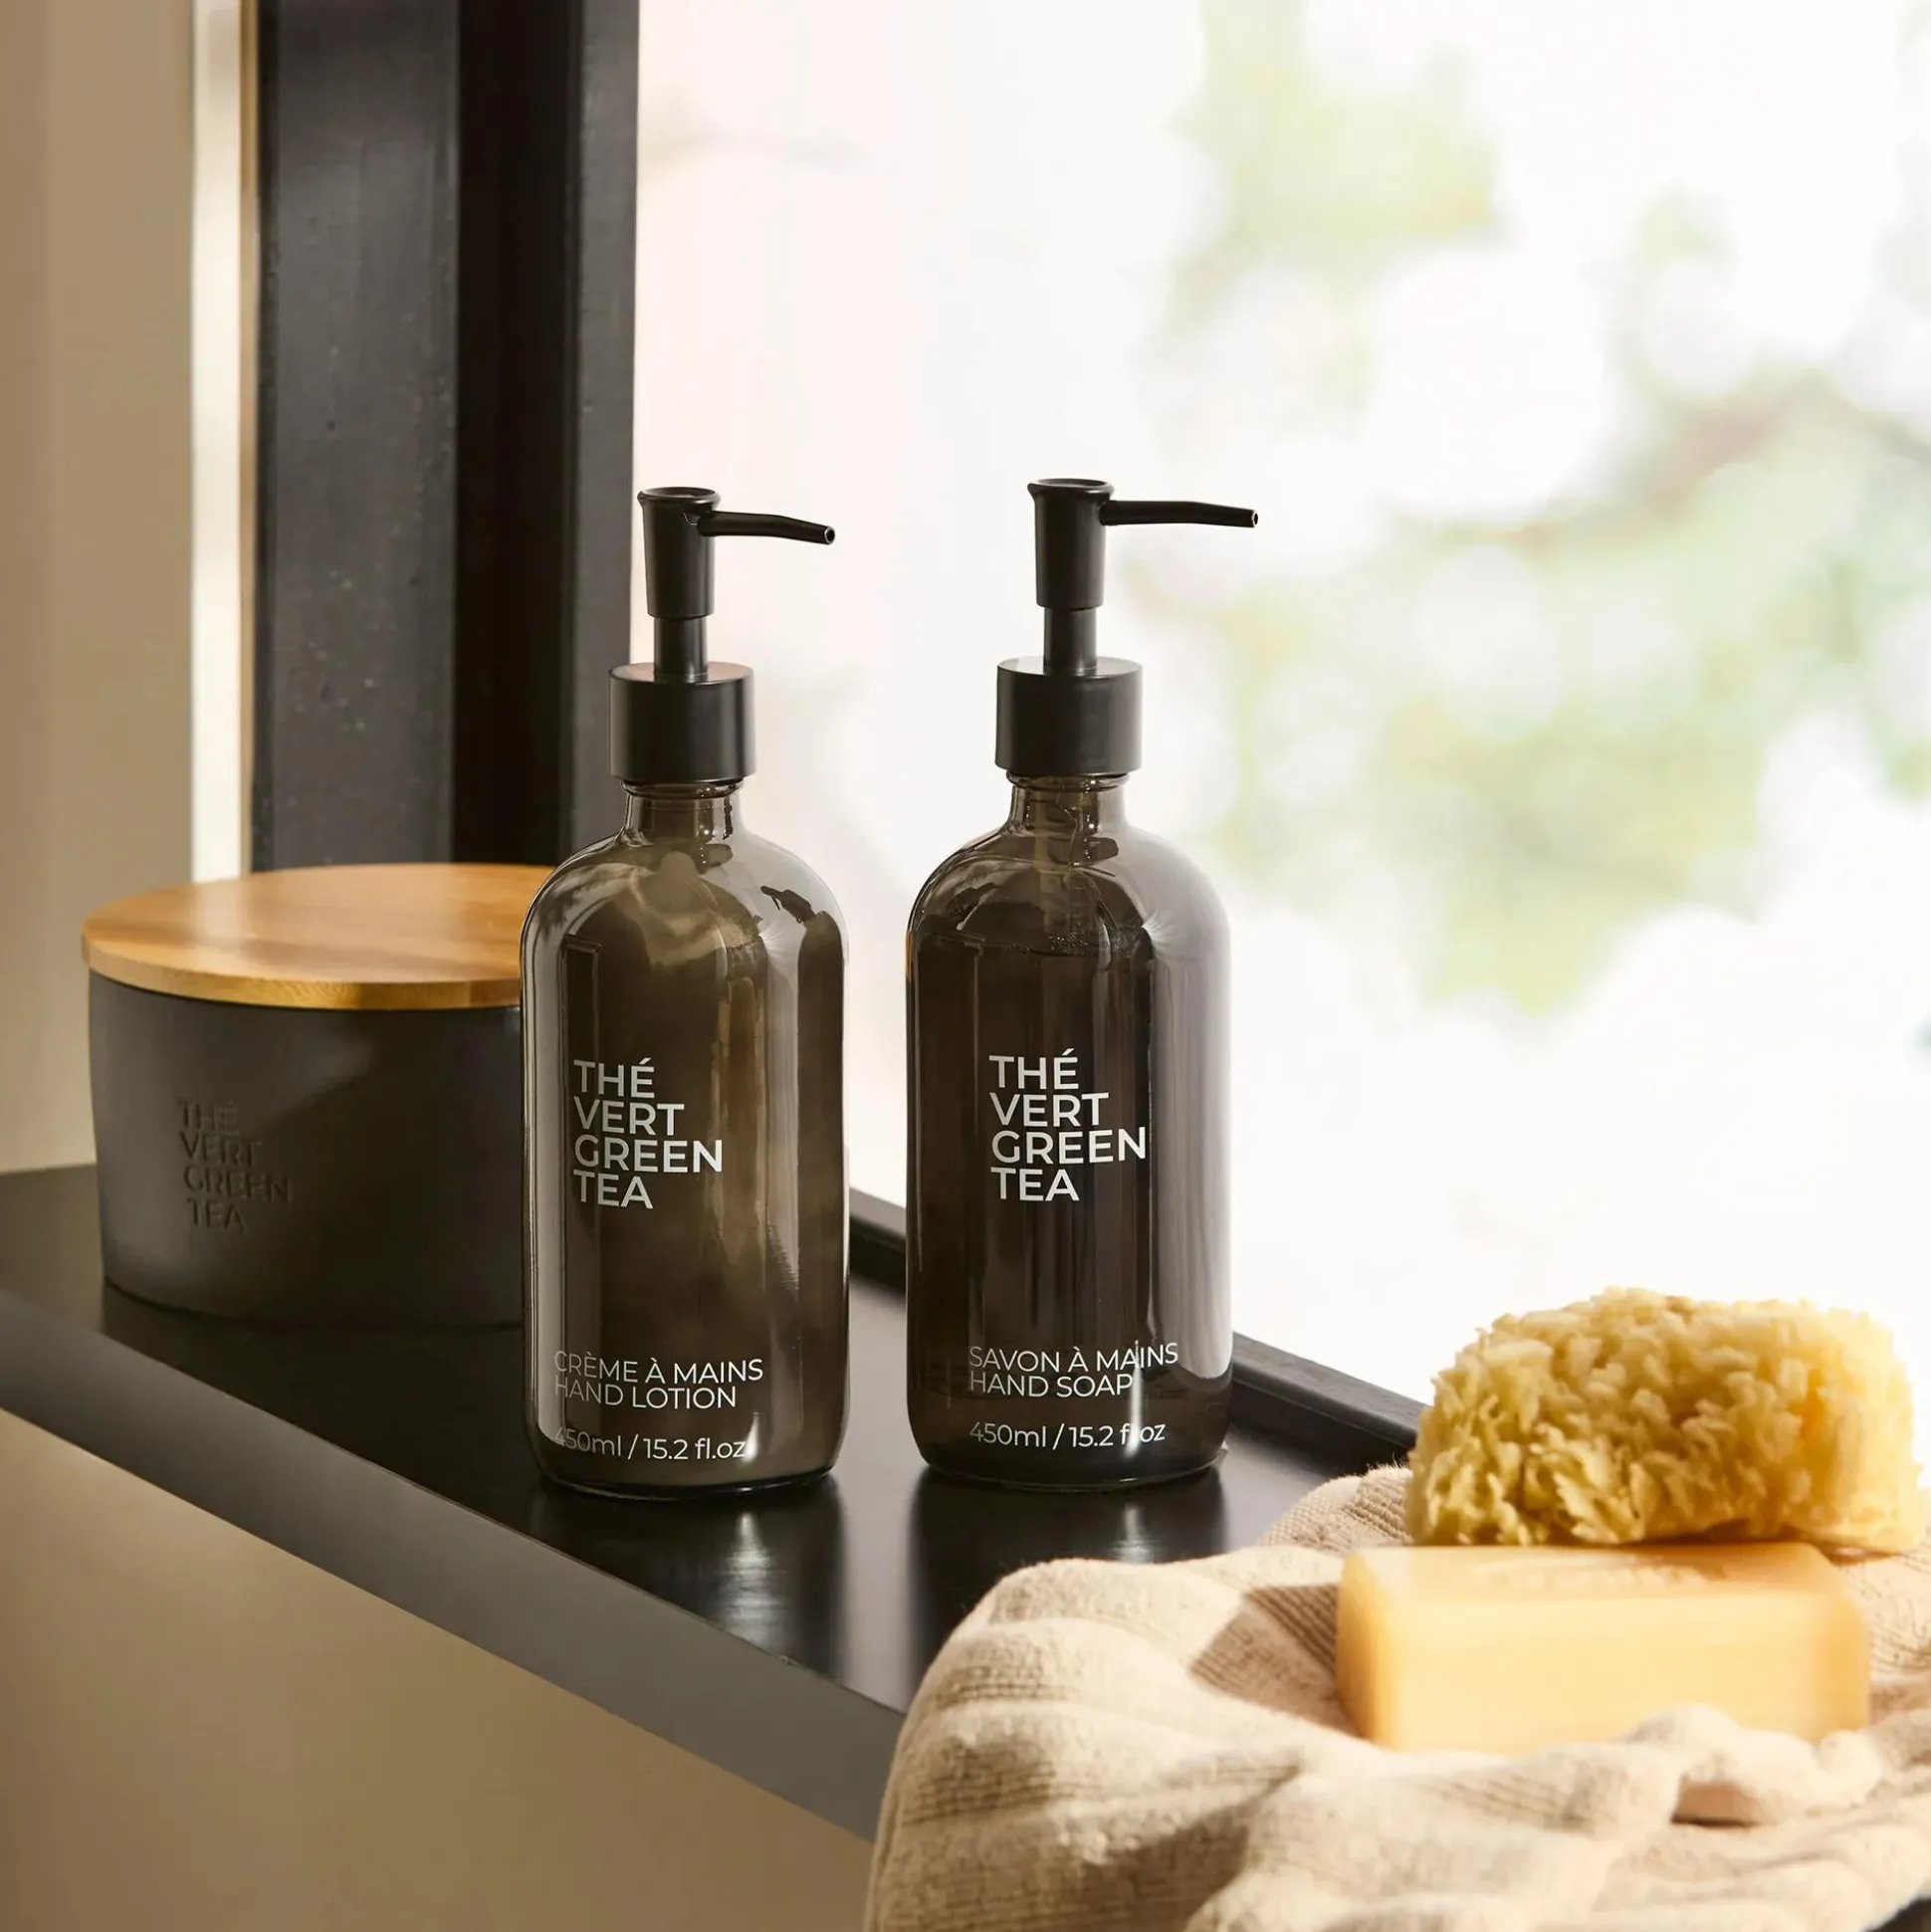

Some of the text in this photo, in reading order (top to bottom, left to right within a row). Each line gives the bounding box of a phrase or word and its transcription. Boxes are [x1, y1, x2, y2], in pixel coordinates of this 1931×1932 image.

[573, 1057, 655, 1099] THÉ
[988, 1048, 1079, 1090] THÉ
[573, 1096, 685, 1136] VERT
[989, 1092, 1110, 1127] VERT
[180, 1130, 263, 1166] VERT
[574, 1134, 723, 1174] GREEN
[991, 1126, 1147, 1165] GREEN
[183, 1164, 293, 1203] GREEN
[573, 1169, 654, 1209] TEA
[990, 1167, 1080, 1201] TEA
[187, 1196, 249, 1233] TEA
[554, 1351, 763, 1385] CRÈME À MAINS
[968, 1342, 1179, 1373] SAVON À MAINS
[555, 1375, 736, 1409] HAND LOTION
[970, 1371, 1134, 1397] HAND SOAP
[554, 1426, 621, 1456] 450ml
[643, 1438, 689, 1459] 15.2
[695, 1437, 747, 1459] fl.oz
[969, 1421, 1046, 1447] 450ml
[1068, 1425, 1114, 1447] 15.2
